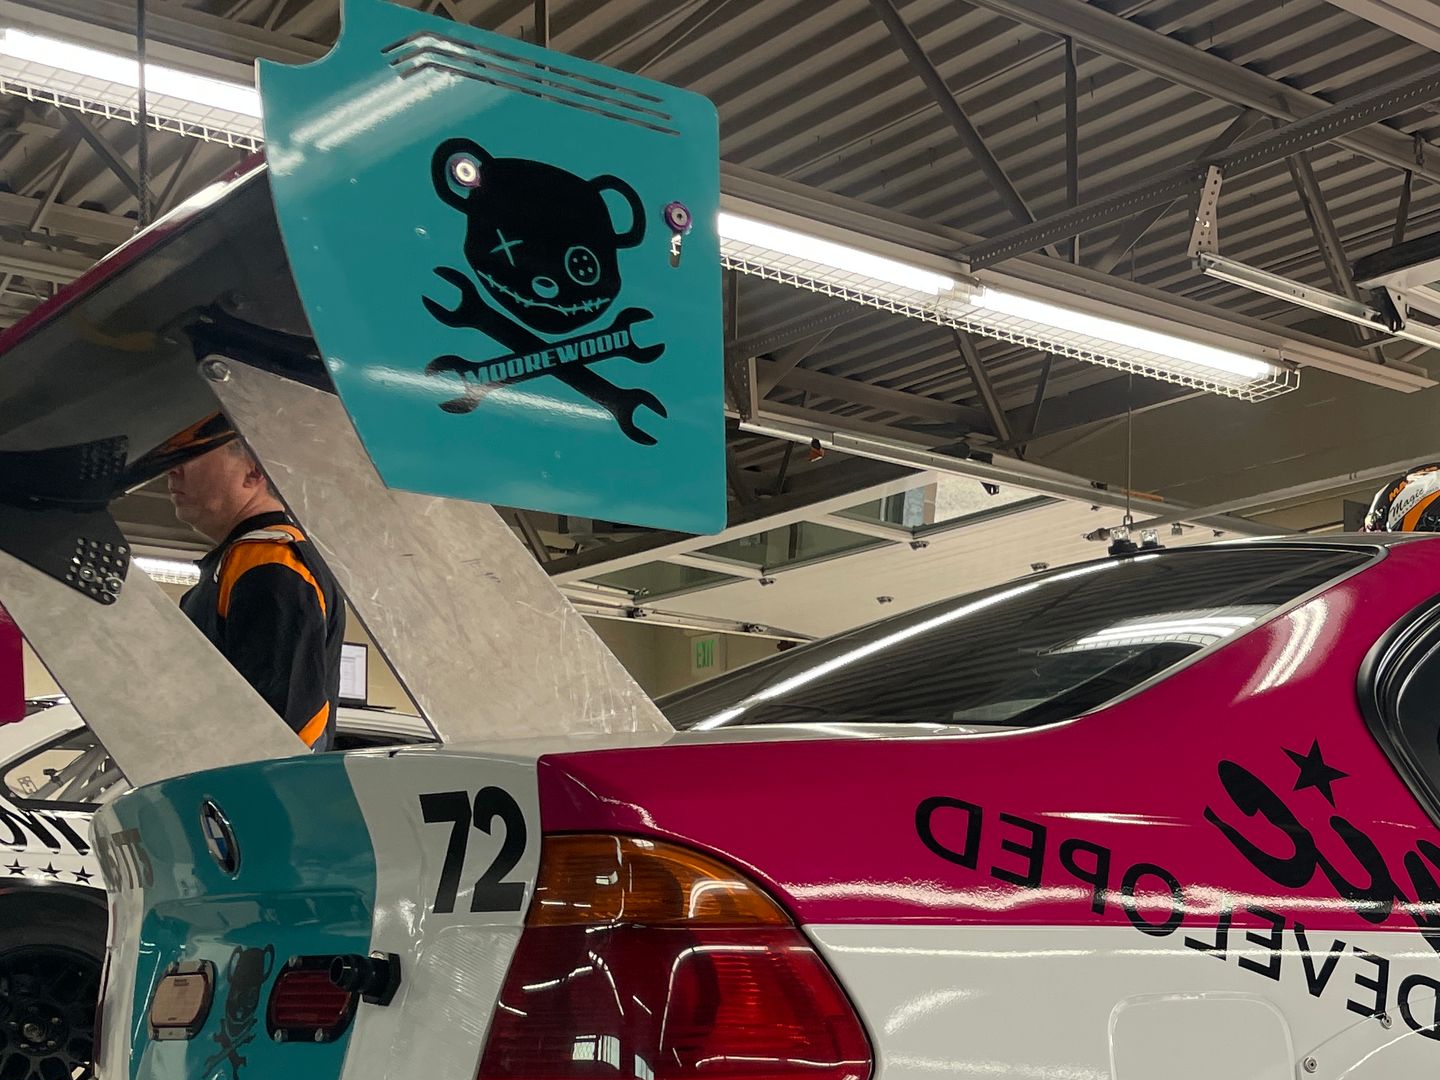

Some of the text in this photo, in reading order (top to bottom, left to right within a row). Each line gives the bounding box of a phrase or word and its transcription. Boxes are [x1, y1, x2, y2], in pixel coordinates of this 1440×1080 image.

[465, 330, 630, 385] MOOREWOOD
[1390, 488, 1424, 518] Magic
[696, 640, 716, 668] EXIT
[418, 786, 527, 914] 72
